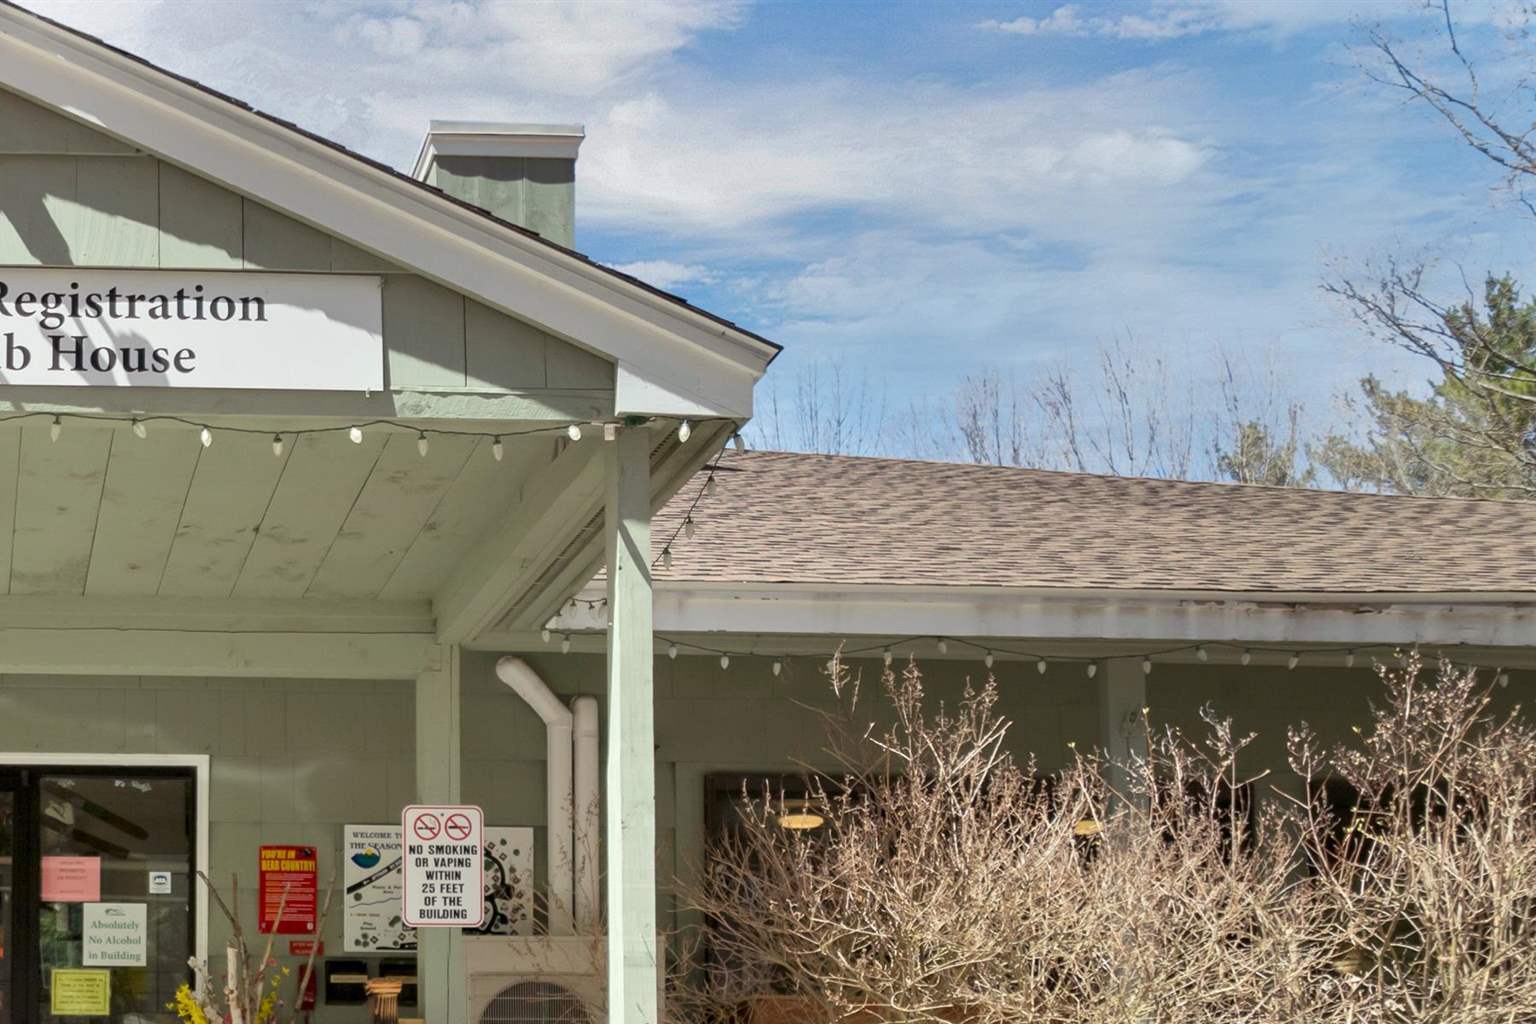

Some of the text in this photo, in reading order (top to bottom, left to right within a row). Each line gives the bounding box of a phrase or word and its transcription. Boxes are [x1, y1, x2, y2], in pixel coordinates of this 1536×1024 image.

[48, 335, 197, 374] House
[352, 831, 392, 839] WELCOME
[409, 844, 478, 856] NO SMOKING
[415, 857, 472, 868] OR VAPING
[425, 870, 462, 881] WITHIN
[421, 883, 465, 894] 25 FEET
[424, 896, 463, 907] OF THE
[419, 909, 468, 919] BUILDING
[90, 920, 139, 932] Absolutely
[88, 936, 142, 945] No Alcohol
[88, 951, 142, 962] in Building
